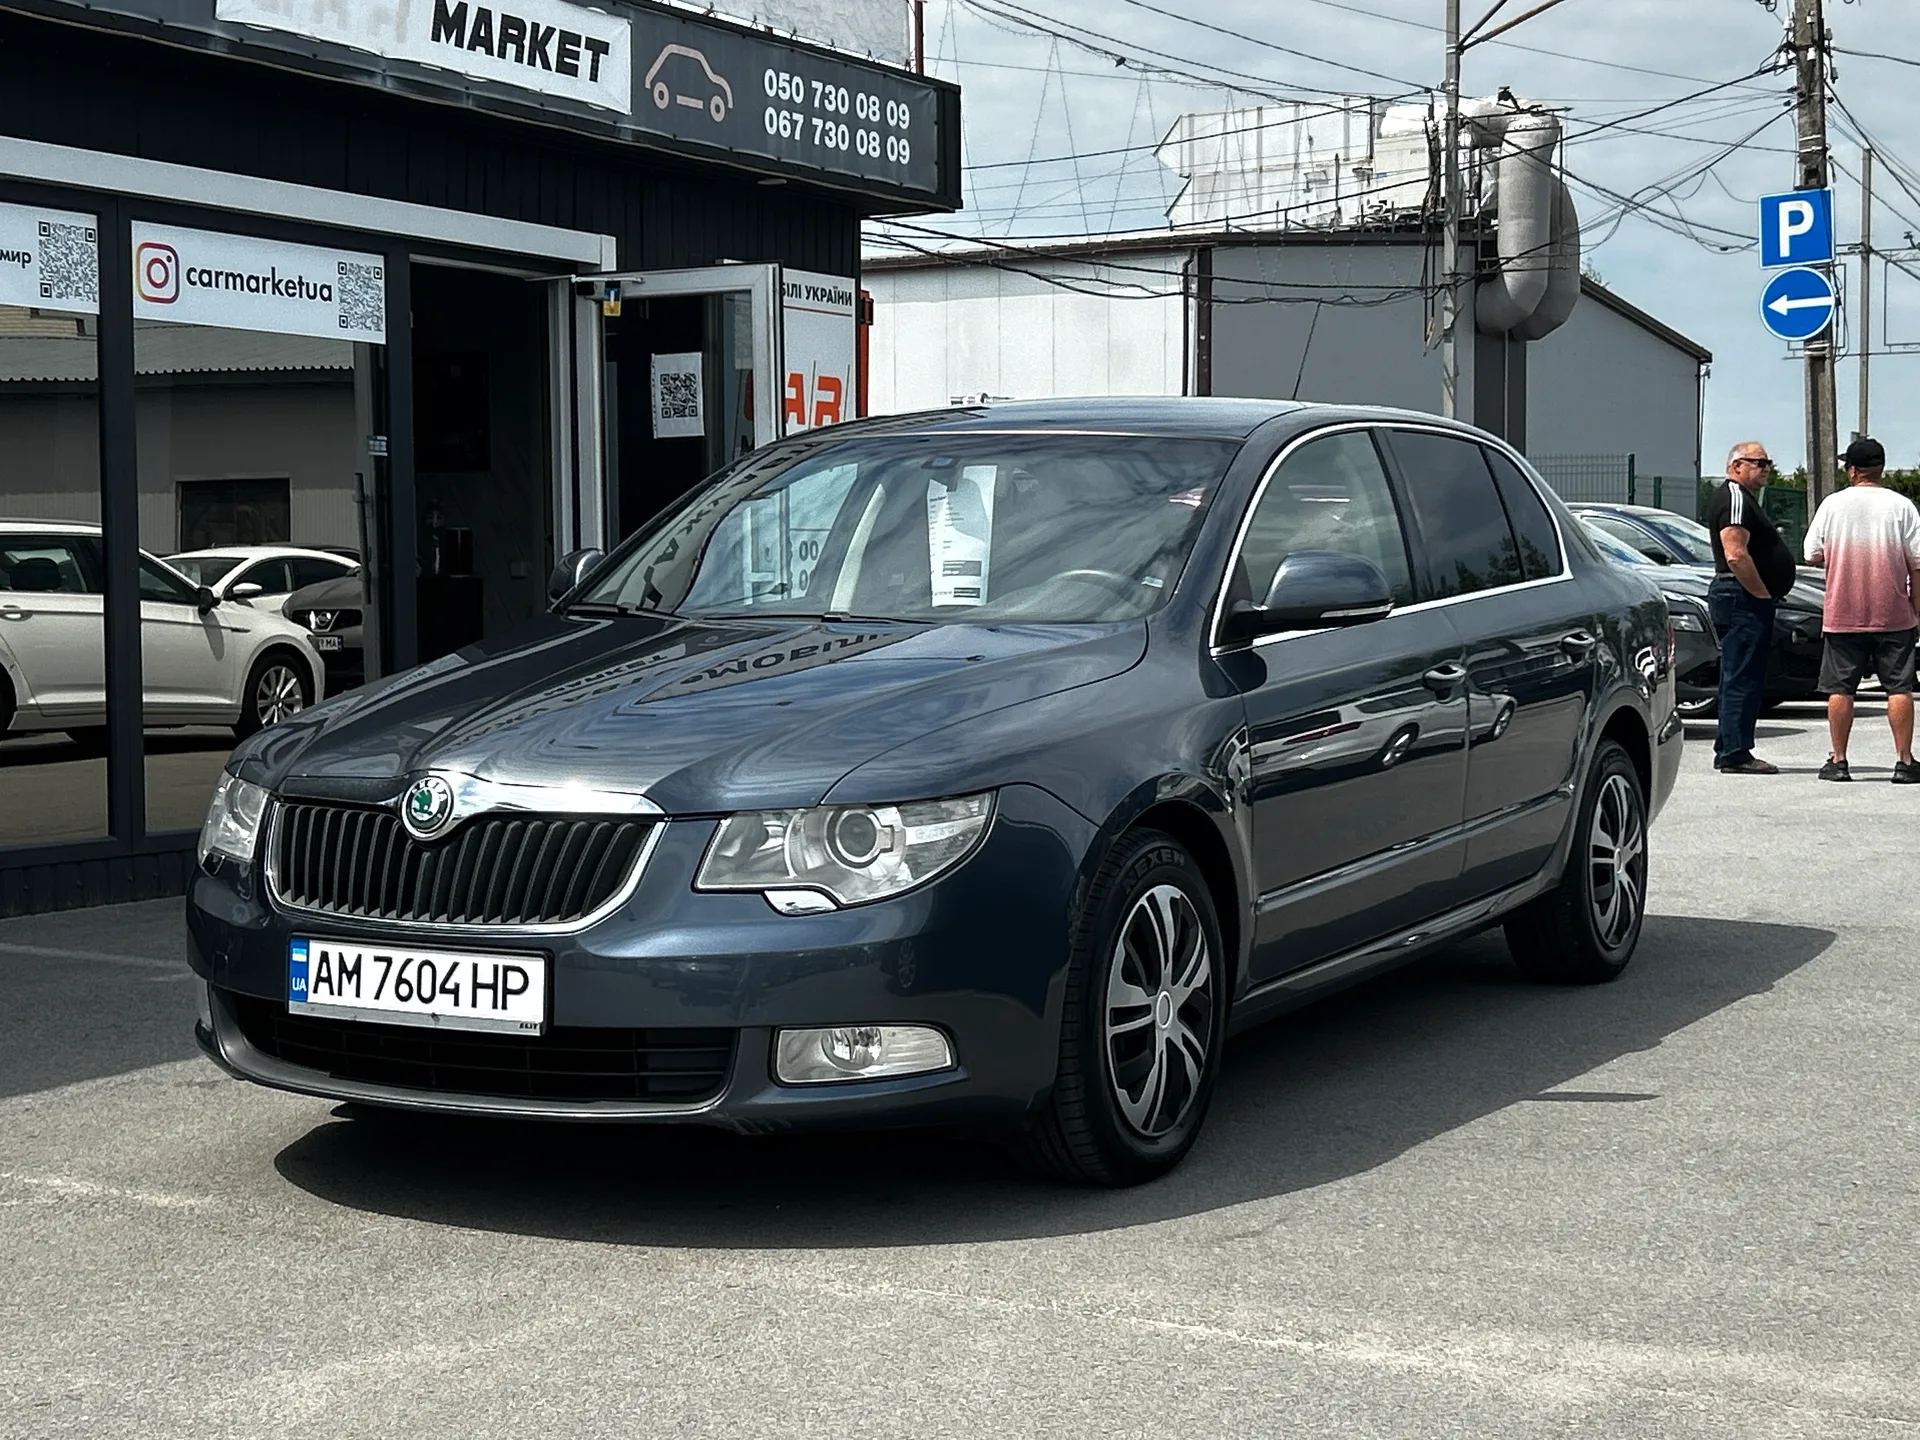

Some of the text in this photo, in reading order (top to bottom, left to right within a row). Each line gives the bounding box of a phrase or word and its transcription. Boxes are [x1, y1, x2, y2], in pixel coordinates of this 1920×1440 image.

[431, 0, 610, 83] MARKET
[764, 68, 910, 130] 050 730 08 09
[764, 106, 911, 165] 067 730 08 09
[1778, 200, 1814, 258] P
[186, 266, 333, 302] carmarketua
[805, 285, 853, 307] УКРАЇНИ
[1123, 848, 1186, 895] NEXEN
[292, 976, 307, 992] UA
[312, 950, 530, 1010] AM 7604 HP
